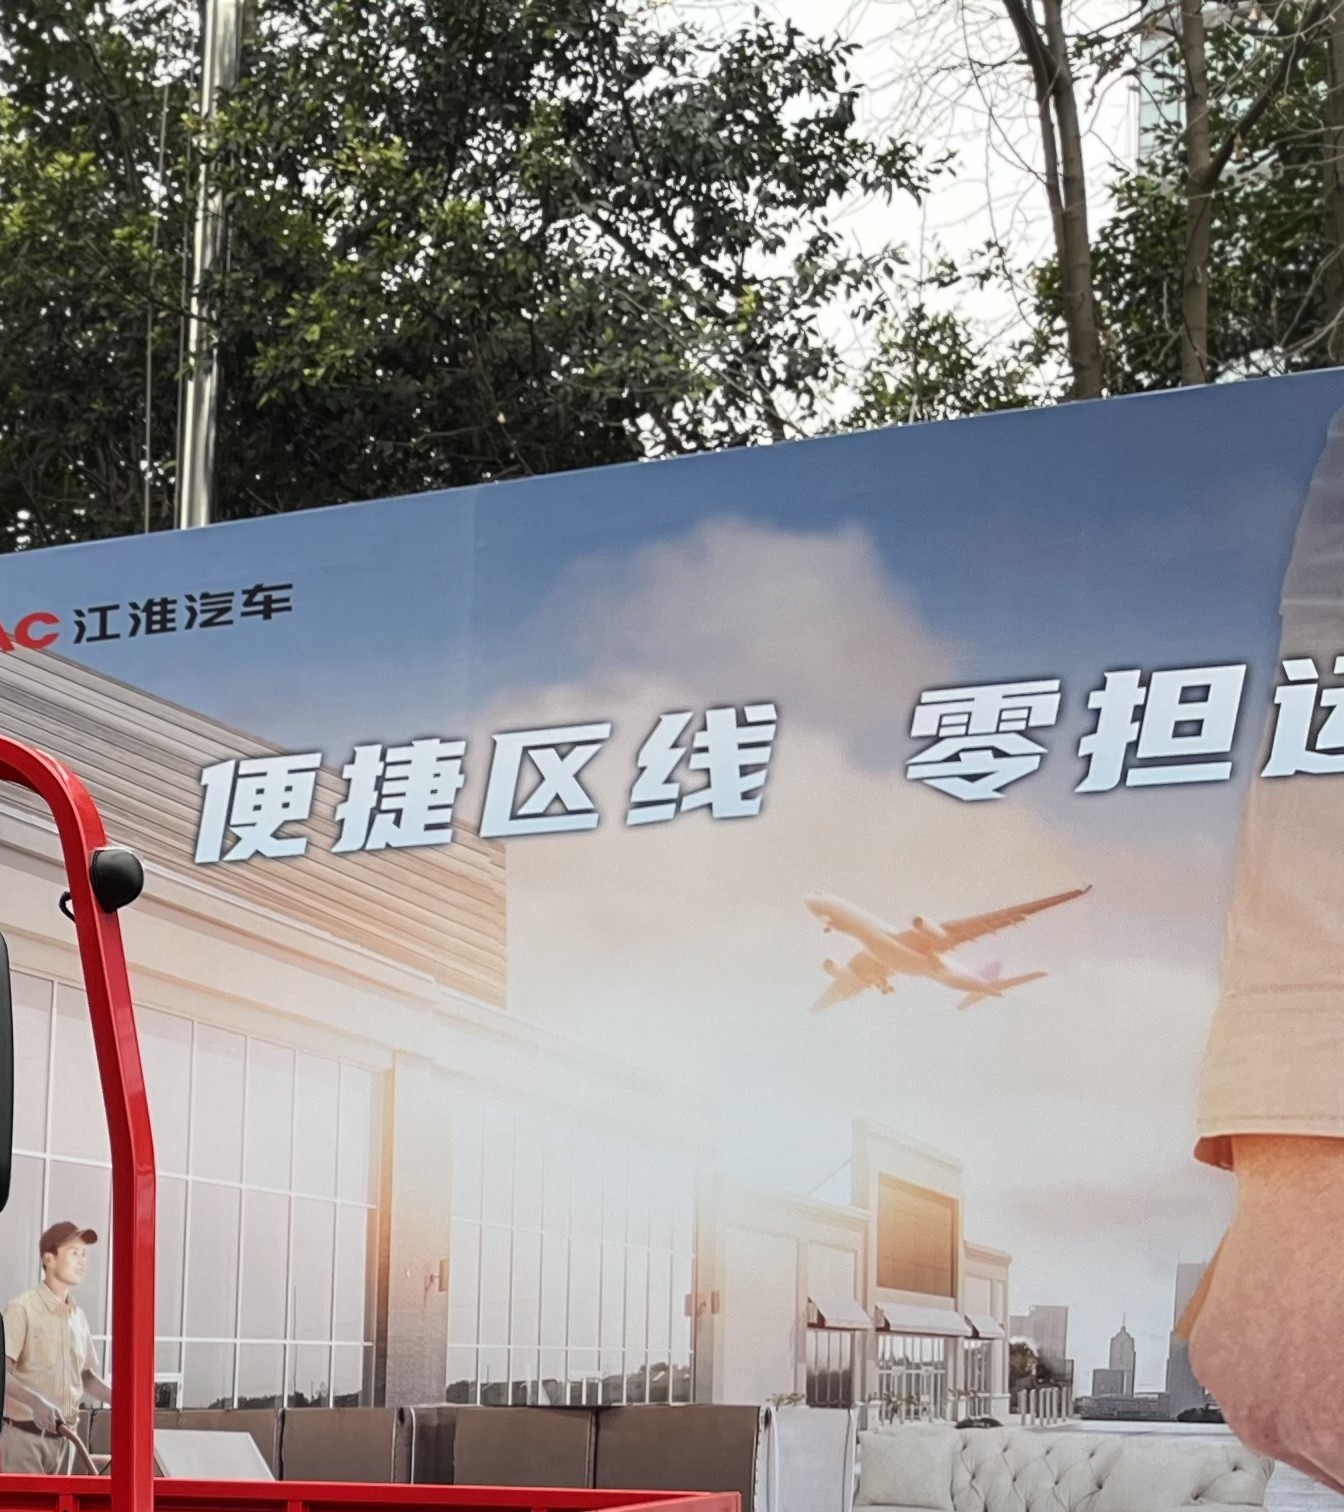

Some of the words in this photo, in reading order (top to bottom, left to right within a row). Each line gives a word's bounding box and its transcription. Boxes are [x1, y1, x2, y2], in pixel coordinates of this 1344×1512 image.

[73, 583, 293, 644] 江淮汽车
[194, 703, 777, 864] 便捷区线
